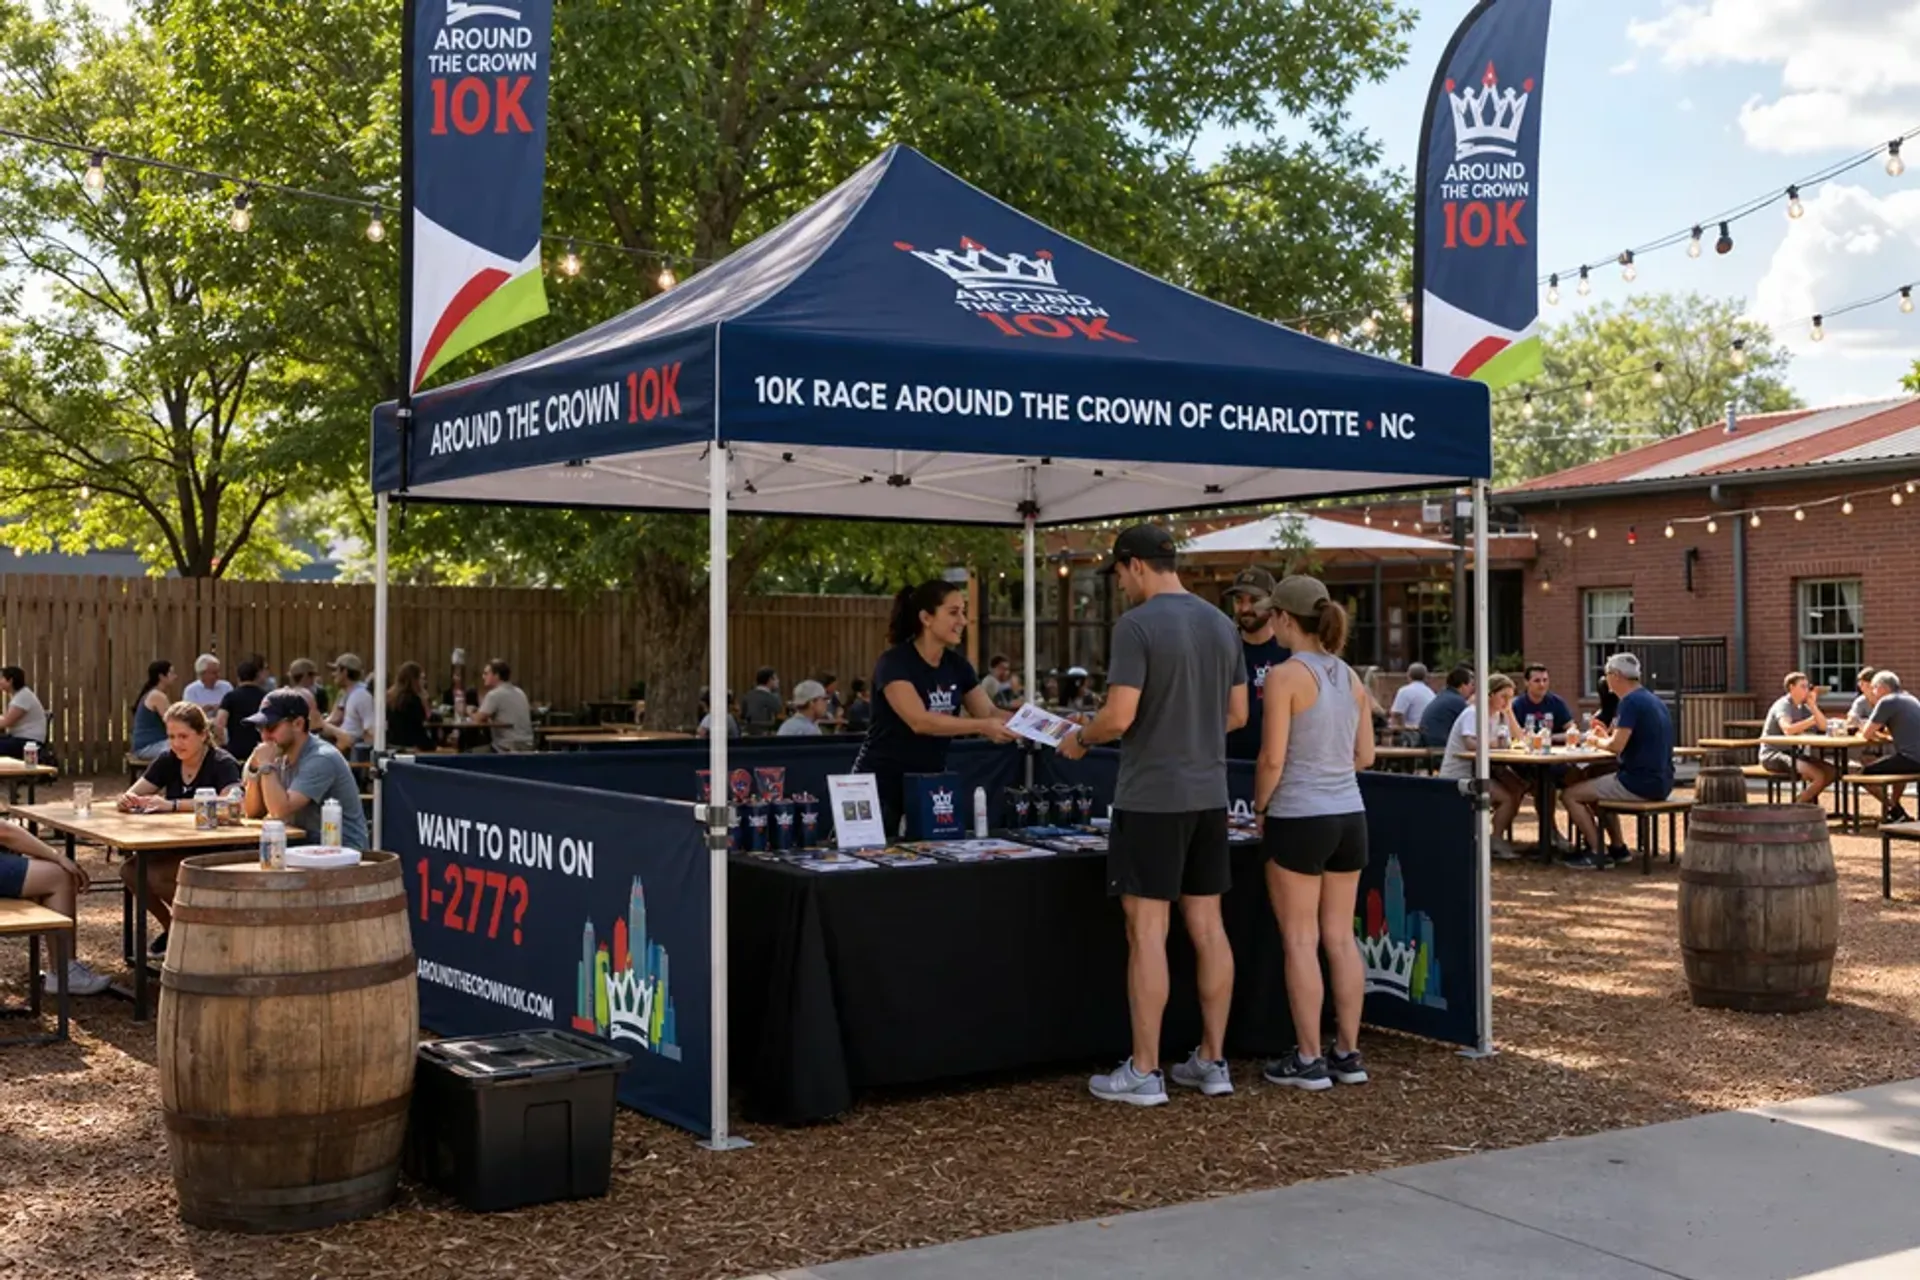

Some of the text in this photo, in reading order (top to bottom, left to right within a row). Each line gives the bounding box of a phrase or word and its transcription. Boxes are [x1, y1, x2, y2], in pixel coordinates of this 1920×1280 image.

[434, 27, 533, 50] AROUND
[428, 52, 537, 73] THE CROWN
[431, 76, 533, 135] 10K
[1444, 162, 1525, 181] AROUND
[1440, 182, 1529, 198] THE CROWN
[1443, 200, 1527, 248] 10K
[955, 300, 1110, 317] THE CROWN
[956, 288, 1092, 306] AROUND
[977, 312, 1138, 343] 10K
[430, 362, 682, 456] AROUND THE CROWN 10K
[754, 376, 1416, 440] 10K RACE AROUND THE CROWN OF CHARLOTTE NC
[417, 811, 594, 879] WANT TO RUN ON
